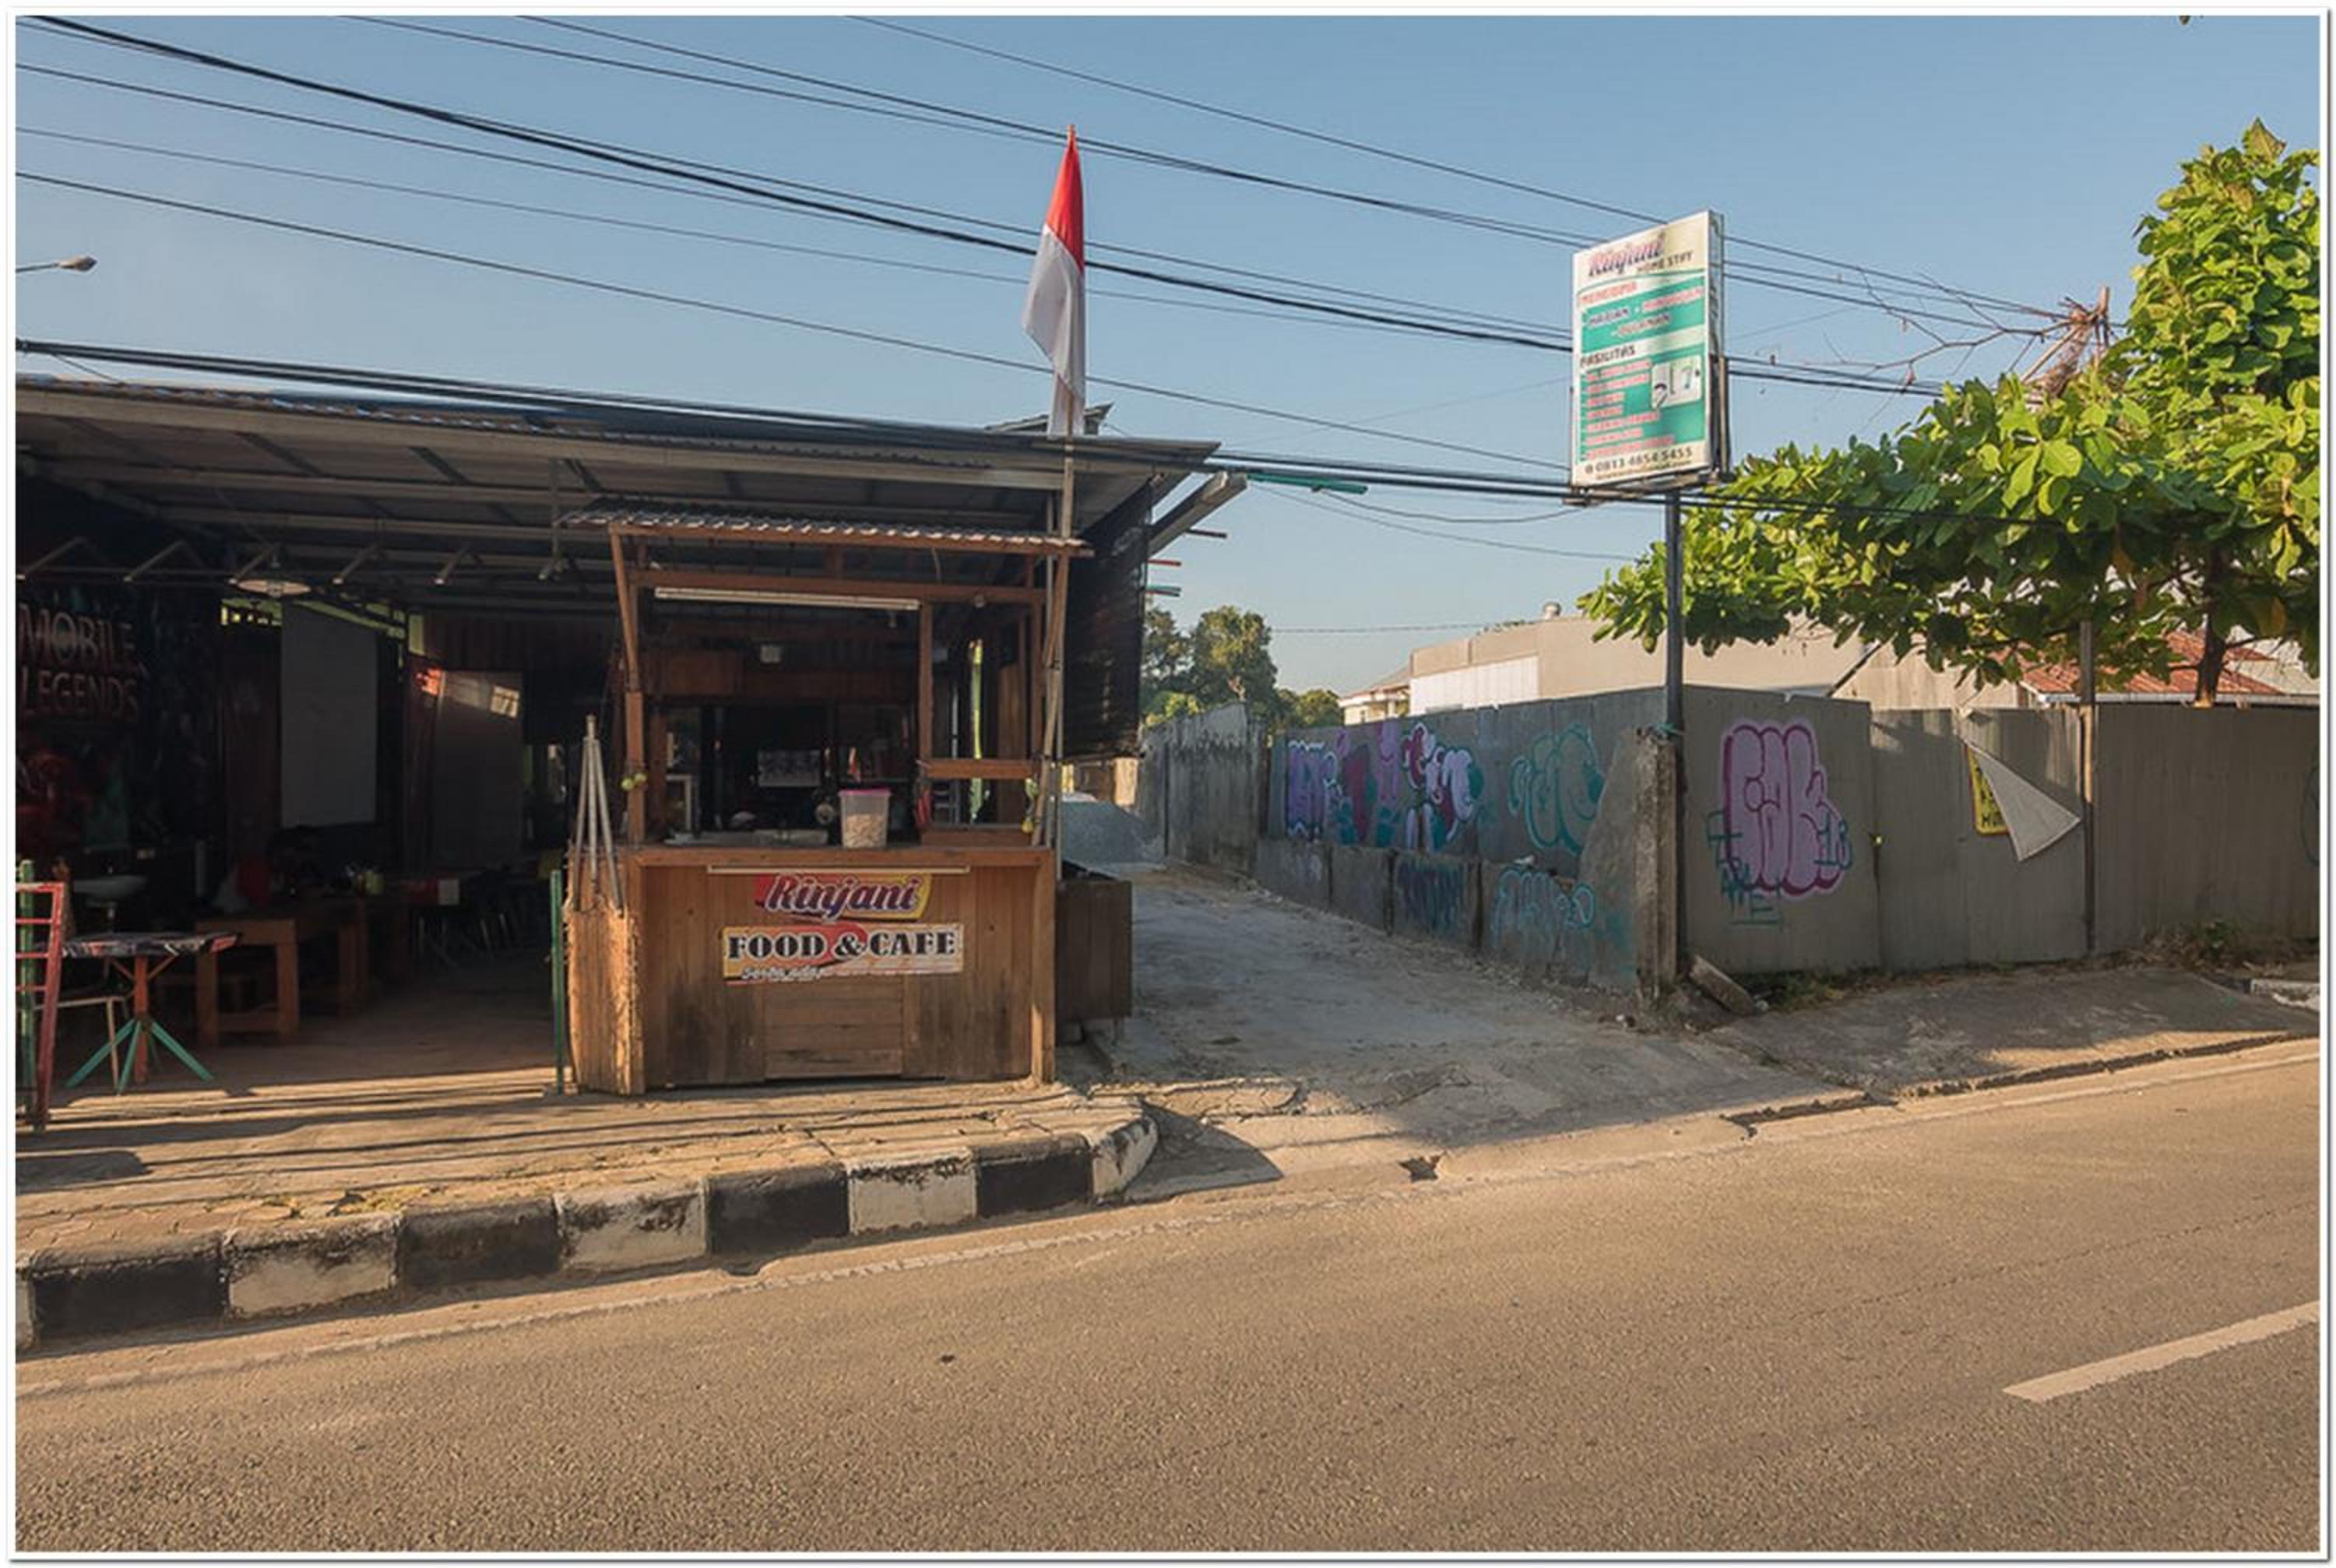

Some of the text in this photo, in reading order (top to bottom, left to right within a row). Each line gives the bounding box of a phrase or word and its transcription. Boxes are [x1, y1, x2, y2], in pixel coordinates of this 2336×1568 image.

[16, 602, 135, 670] MOBILE
[17, 666, 139, 721] LEGENDS
[766, 874, 920, 921] Rinjani
[727, 931, 955, 959] FOOD & CAFE
